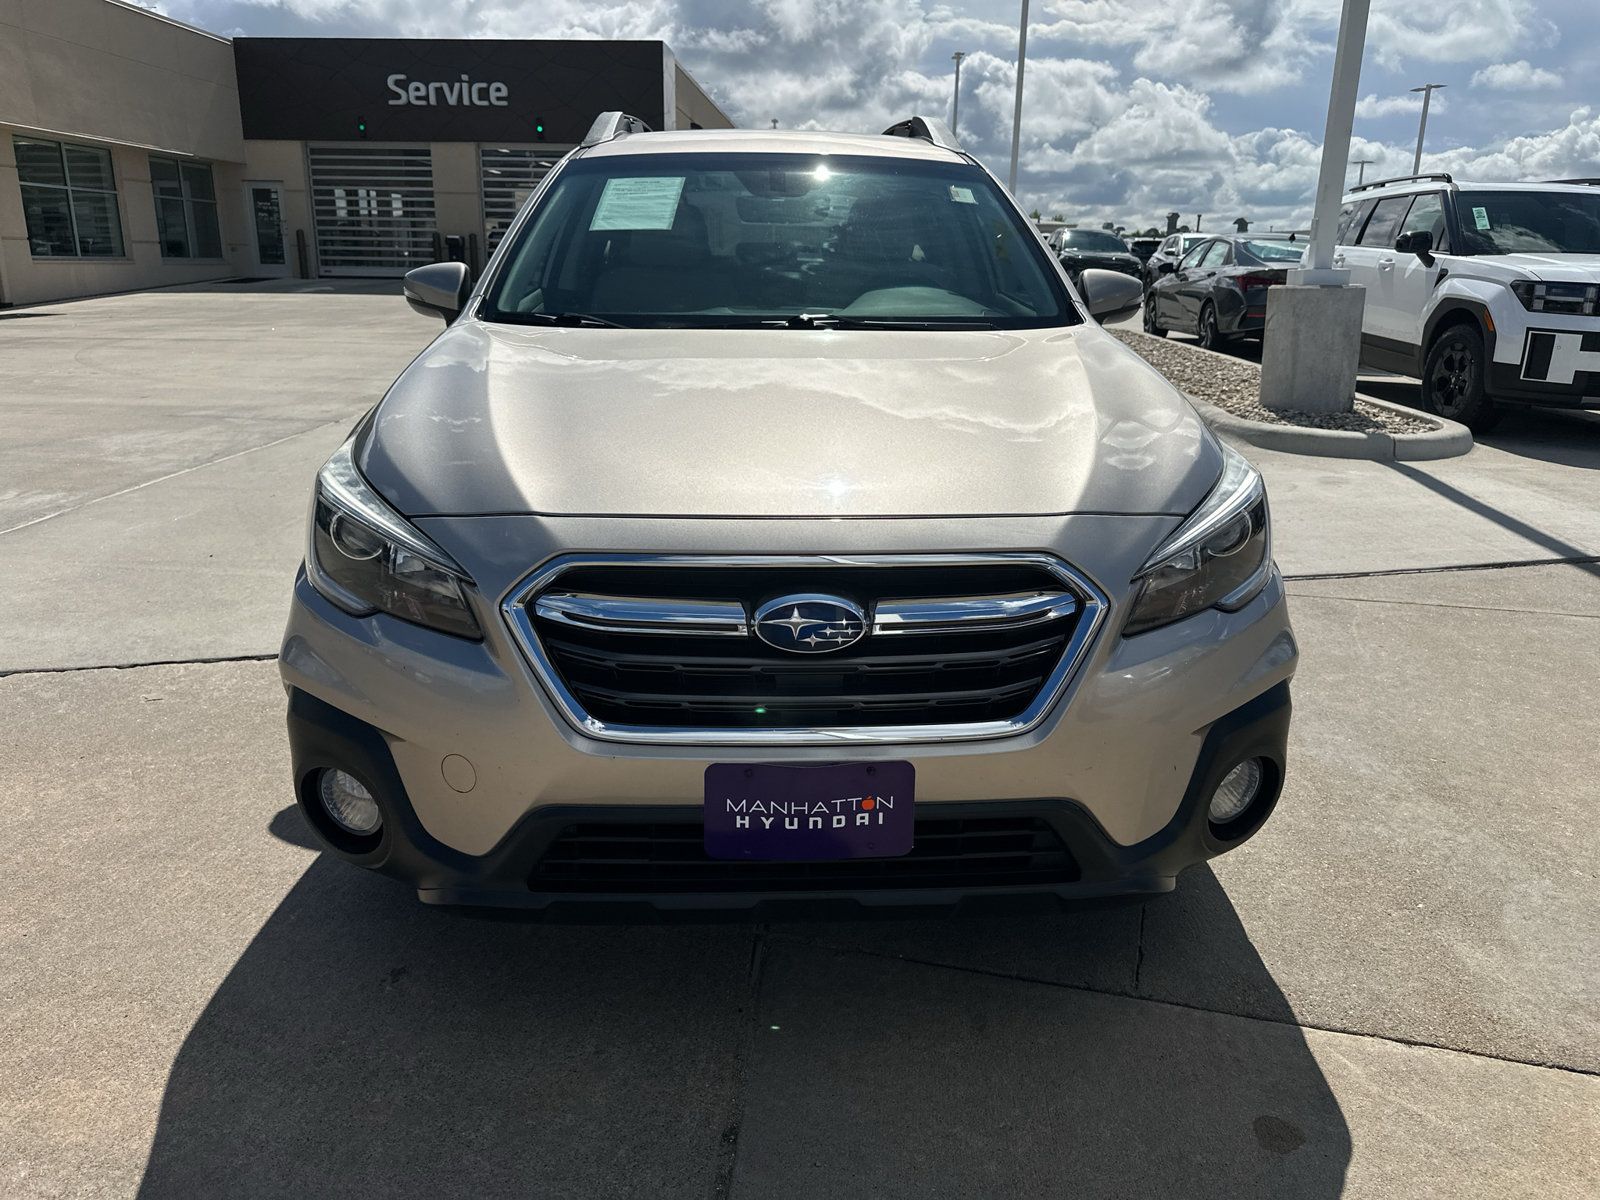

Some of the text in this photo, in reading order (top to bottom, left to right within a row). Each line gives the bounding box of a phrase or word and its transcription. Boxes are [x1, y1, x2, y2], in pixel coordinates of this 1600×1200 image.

[387, 74, 509, 106] Service
[726, 796, 894, 815] MANHATTN
[736, 812, 884, 829] HYUNDAI
